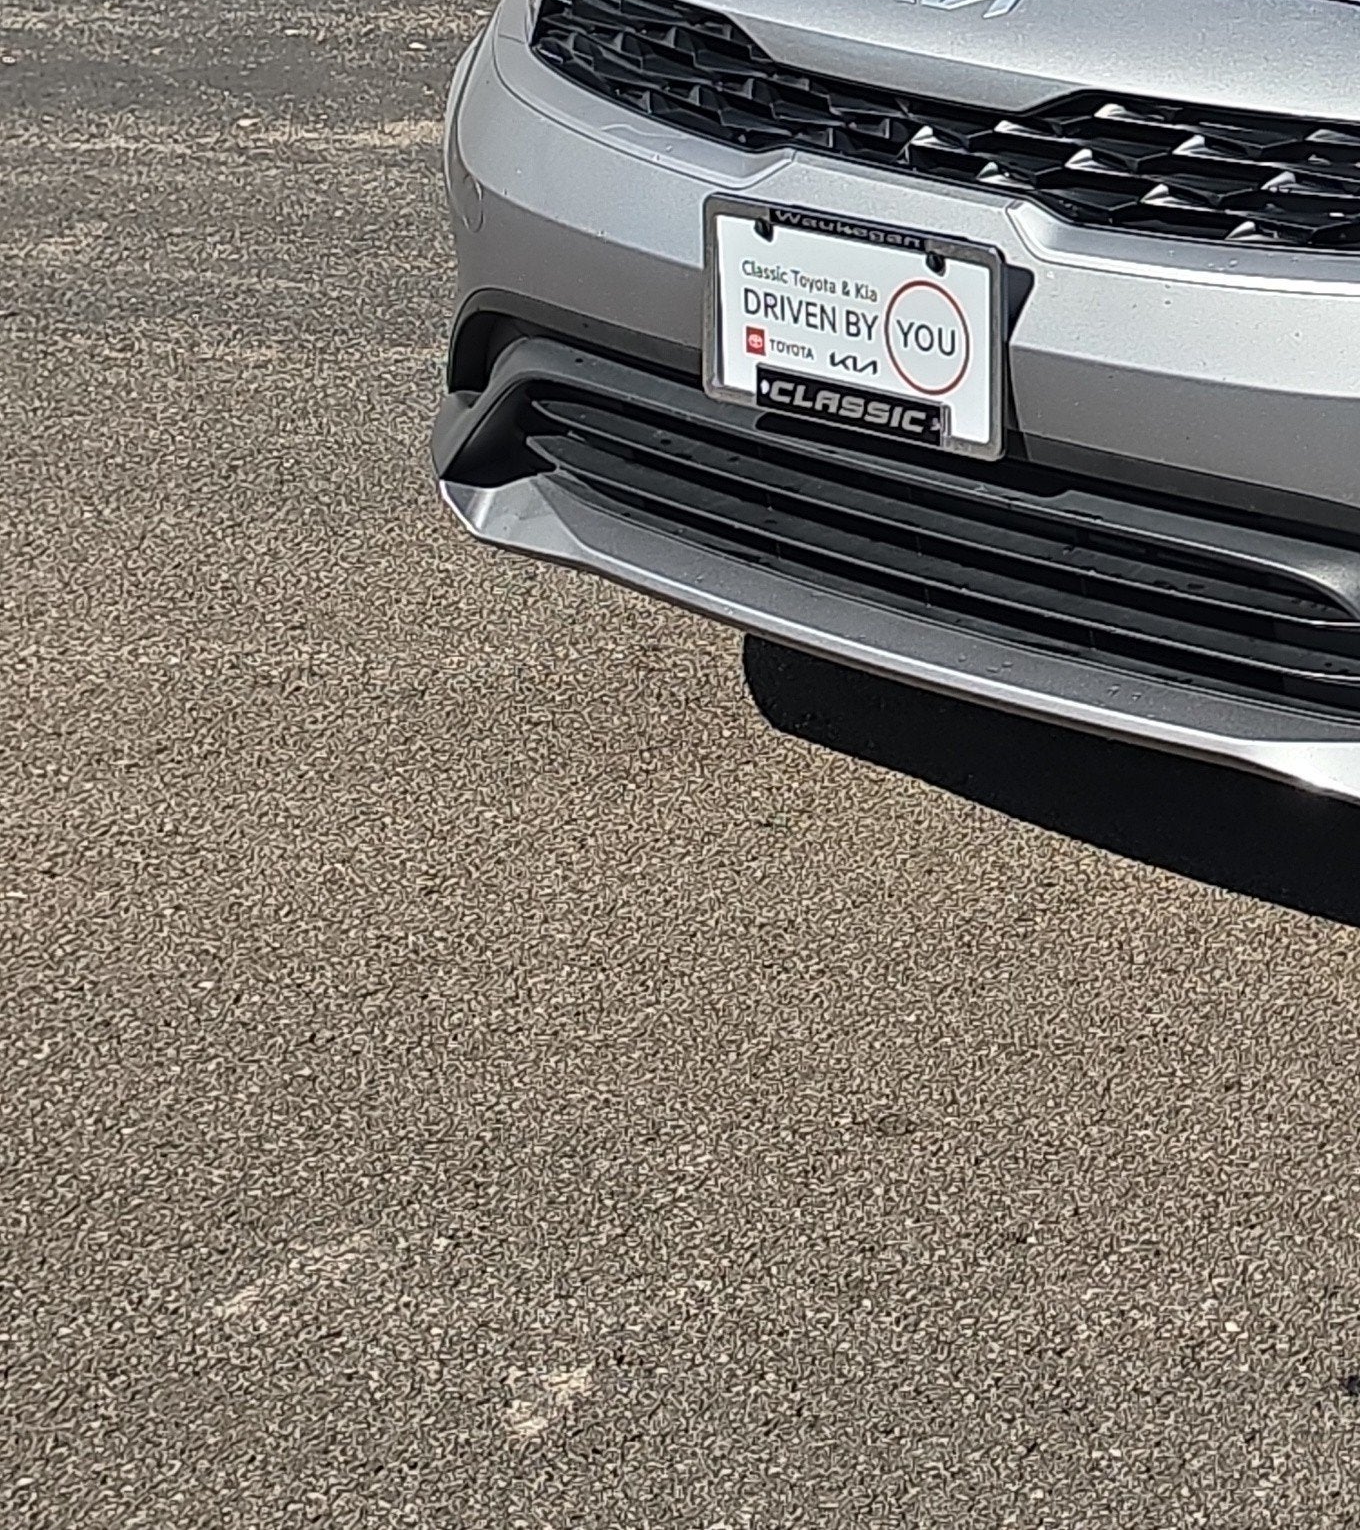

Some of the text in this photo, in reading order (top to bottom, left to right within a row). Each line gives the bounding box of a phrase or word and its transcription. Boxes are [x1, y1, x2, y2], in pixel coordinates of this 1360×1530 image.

[774, 209, 921, 249] Waukegan
[742, 259, 878, 303] Classic Toyota & Kia
[744, 288, 956, 356] DRIVEN BY YOU
[769, 338, 814, 360] TOYOTA
[829, 351, 878, 375] KIA
[768, 380, 929, 433] CLASSIC
